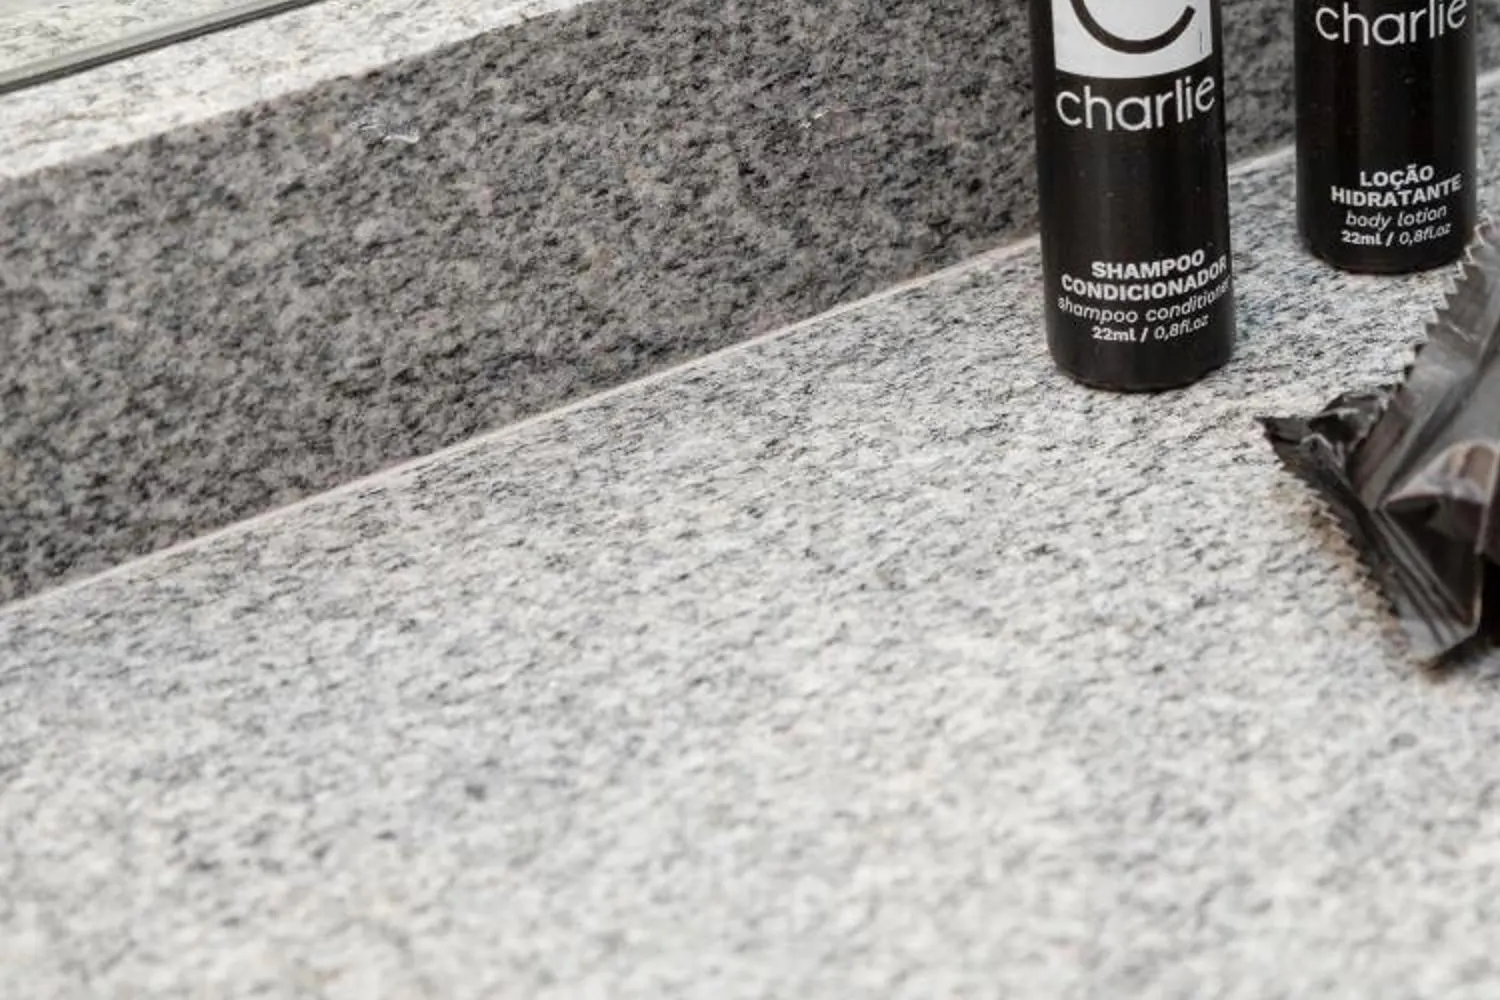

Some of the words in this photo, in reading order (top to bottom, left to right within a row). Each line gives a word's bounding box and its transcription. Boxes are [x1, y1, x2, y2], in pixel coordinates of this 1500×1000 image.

[1055, 75, 1216, 131] charlie
[1330, 173, 1463, 207] HIDRATANTE
[1359, 163, 1435, 190] LOÇÃO
[1345, 211, 1392, 232] body
[1397, 205, 1448, 227] lotion
[1340, 229, 1383, 246] 22ml
[1385, 231, 1395, 248] /
[1060, 255, 1228, 301] CONDICIONADOR
[1091, 249, 1205, 280] SHAMPOO
[1057, 294, 1139, 325] shampoo
[1091, 325, 1137, 342] 22ml
[1139, 327, 1150, 343] /
